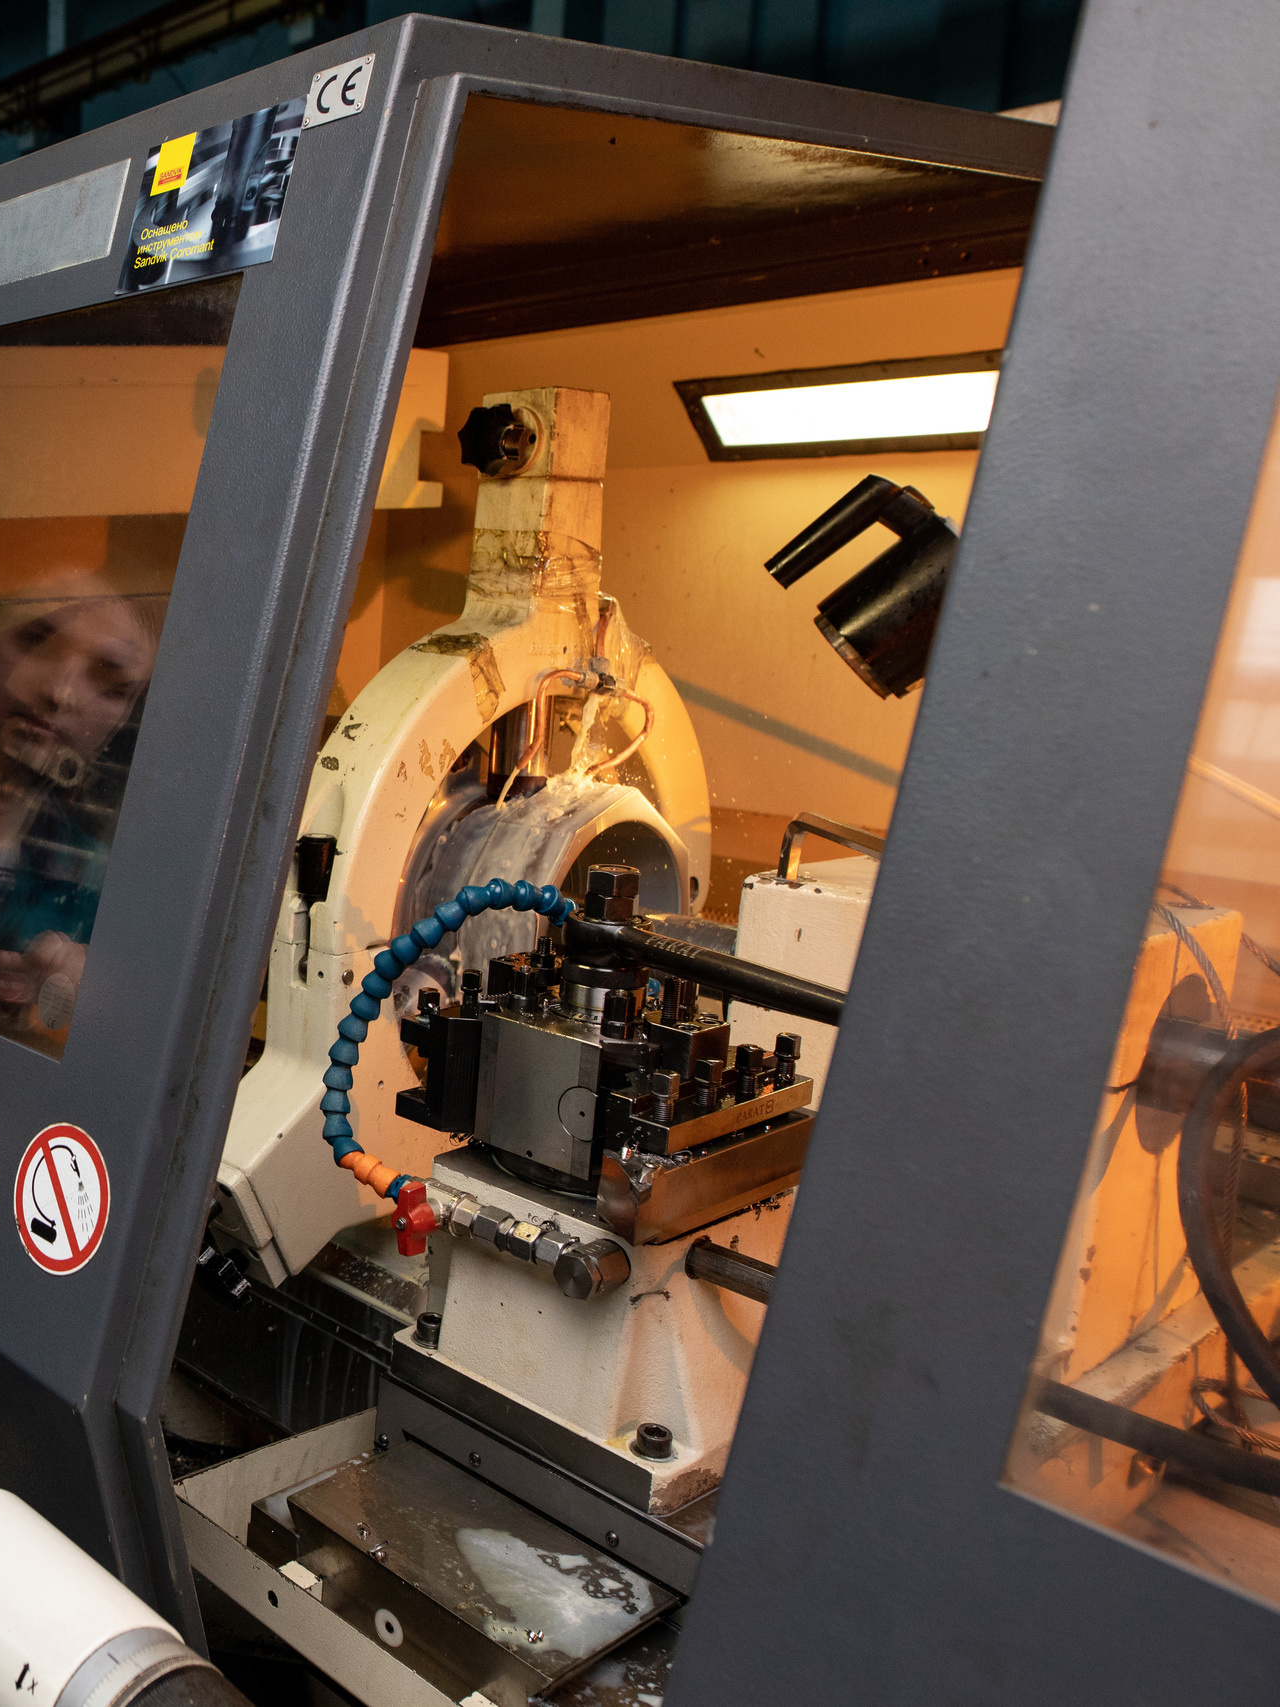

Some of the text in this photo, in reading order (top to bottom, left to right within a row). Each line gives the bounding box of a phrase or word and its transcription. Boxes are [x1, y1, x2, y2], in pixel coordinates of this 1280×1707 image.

[316, 65, 364, 114] CE
[137, 230, 202, 254] инструментом
[141, 220, 188, 240] Оснащено
[134, 239, 215, 269] Sandvik Coromant
[26, 1678, 38, 1695] X
